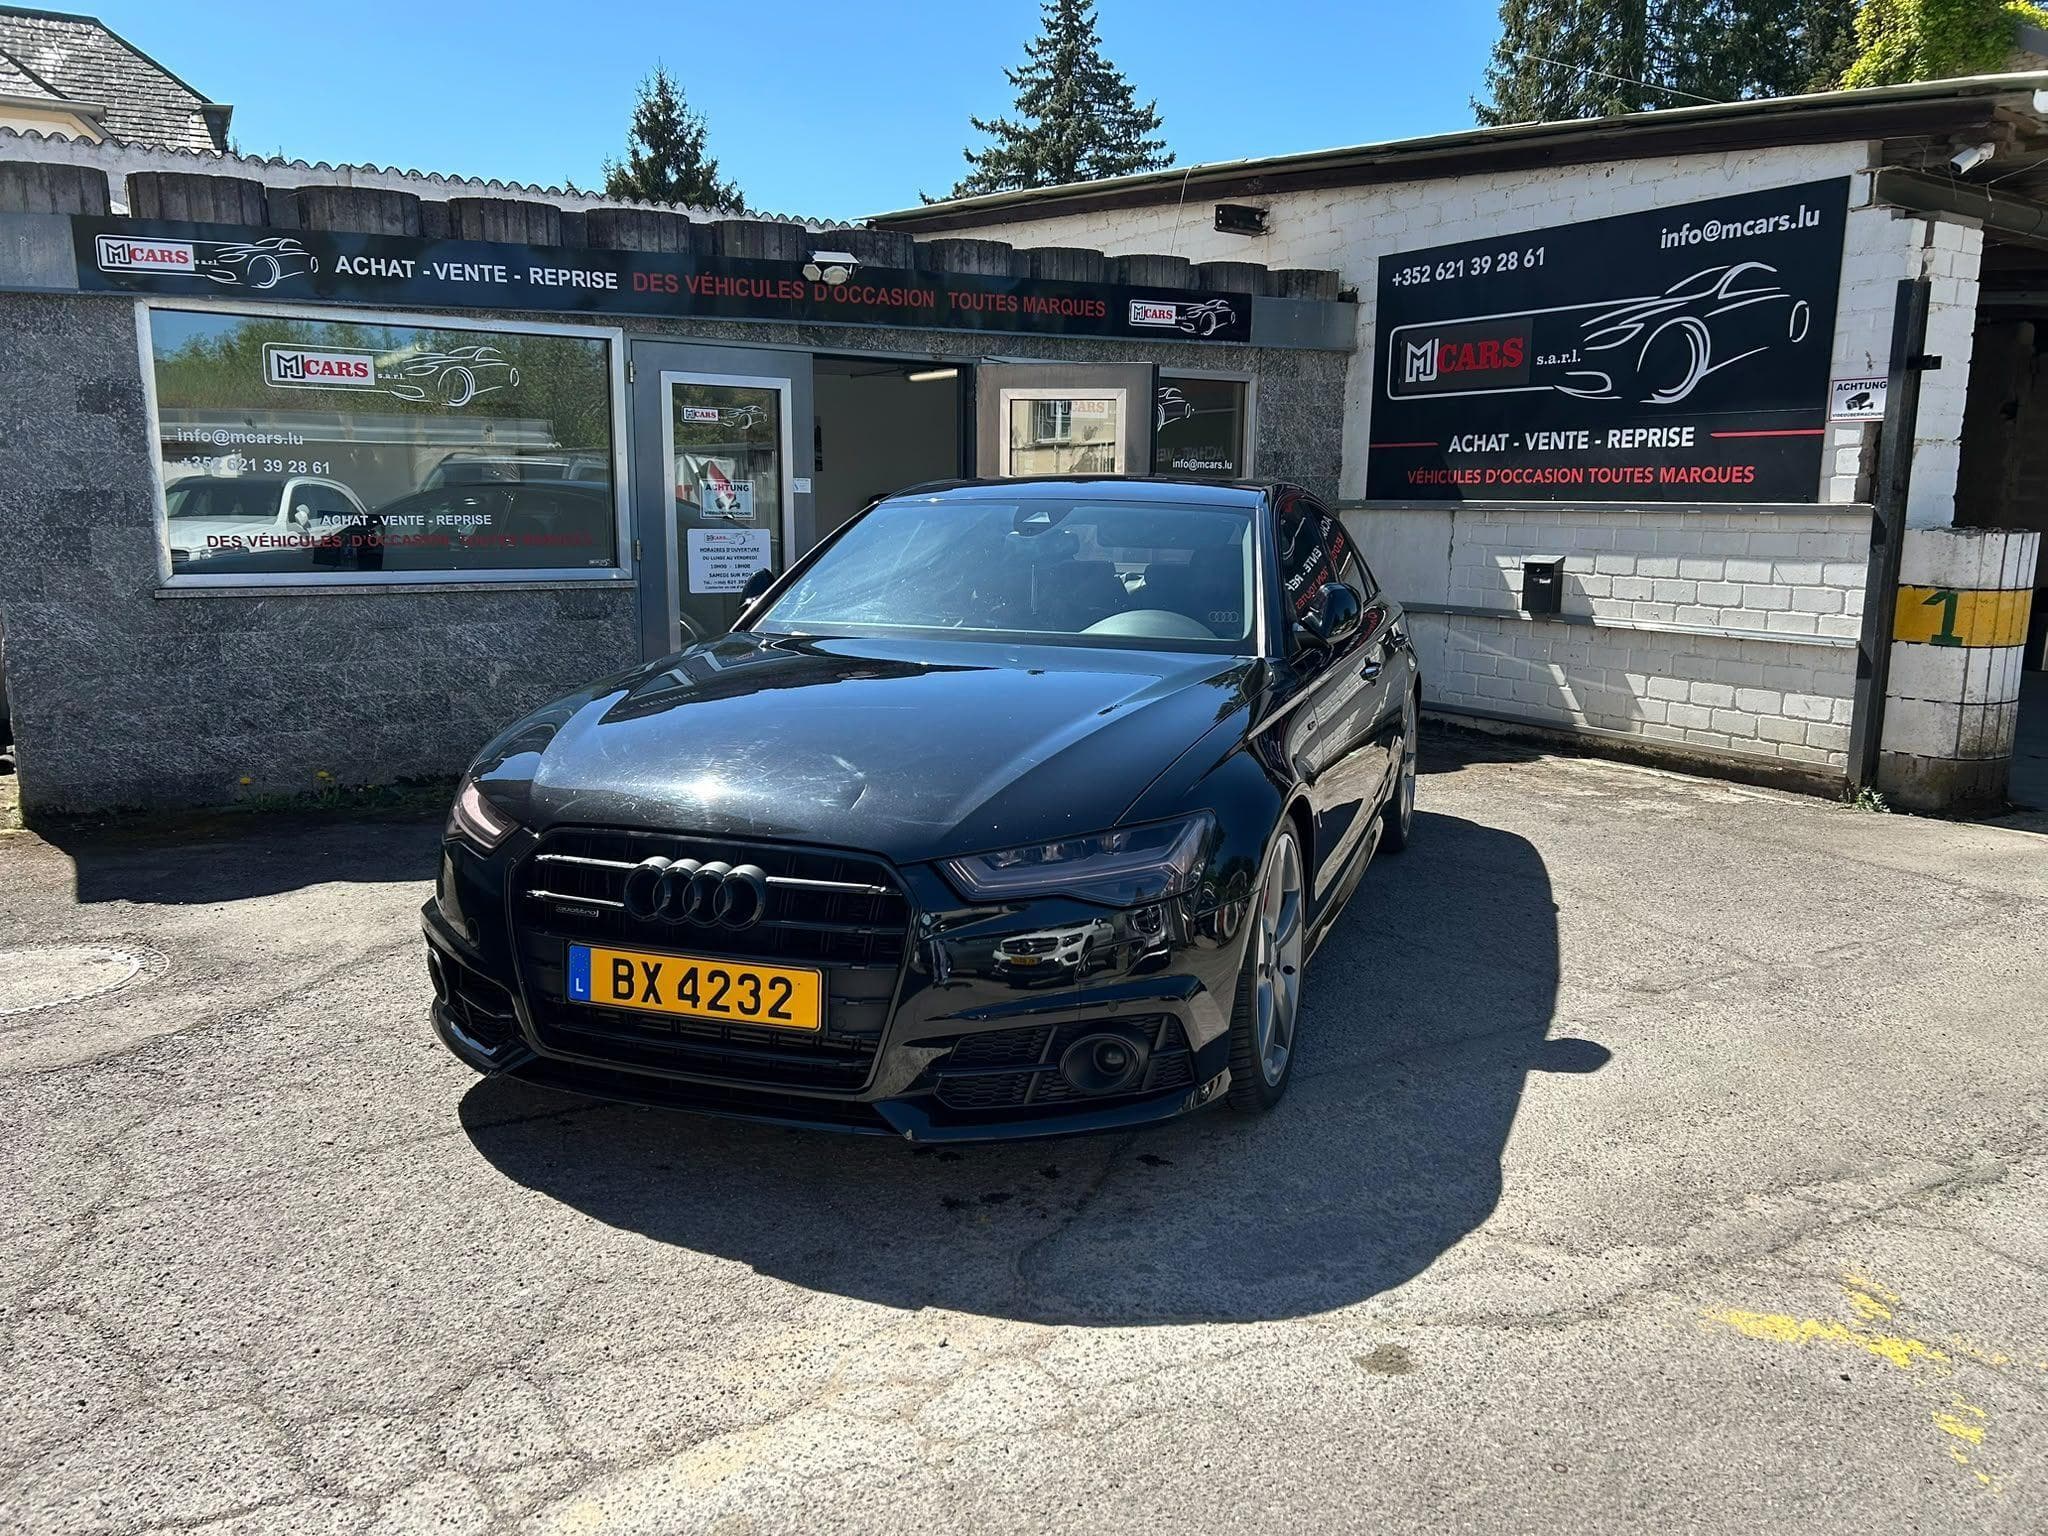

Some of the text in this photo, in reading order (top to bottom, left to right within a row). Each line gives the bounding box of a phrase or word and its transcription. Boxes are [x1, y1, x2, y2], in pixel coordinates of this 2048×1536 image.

[1660, 205, 1820, 249] info@mcars.lu
[1392, 247, 1545, 287] +352 621 39 28 61
[335, 255, 415, 279] ACHAT
[529, 267, 618, 290] REPRISE
[632, 271, 679, 294] DES
[685, 271, 804, 300] VÉHICULES
[814, 283, 935, 308] D'OCCASION
[948, 291, 1018, 312] TOUTES
[1023, 296, 1106, 318] MARQUES
[1536, 349, 1582, 365] s.a.r.l.
[1836, 381, 1887, 392] ACHTUNG
[177, 428, 303, 447] info@mcars.lu
[1447, 434, 1509, 453] ACHAT
[1525, 431, 1589, 451] VENTE
[1607, 426, 1695, 449] REPRISE
[263, 459, 283, 473] 39
[288, 460, 307, 474] 28
[312, 461, 331, 475] 61
[1172, 458, 1233, 471] info@mcars.lu
[1408, 465, 1756, 484] VÉHICULES D'OCCASION TOUTES MARQUES
[320, 515, 369, 526] ACHAT
[380, 515, 425, 526] VENTE
[436, 514, 492, 526] REPRISE
[207, 535, 242, 548] DES
[247, 532, 342, 548] VÉHICULES
[1922, 592, 1964, 646] 1
[575, 957, 793, 1021] L BX 4232
